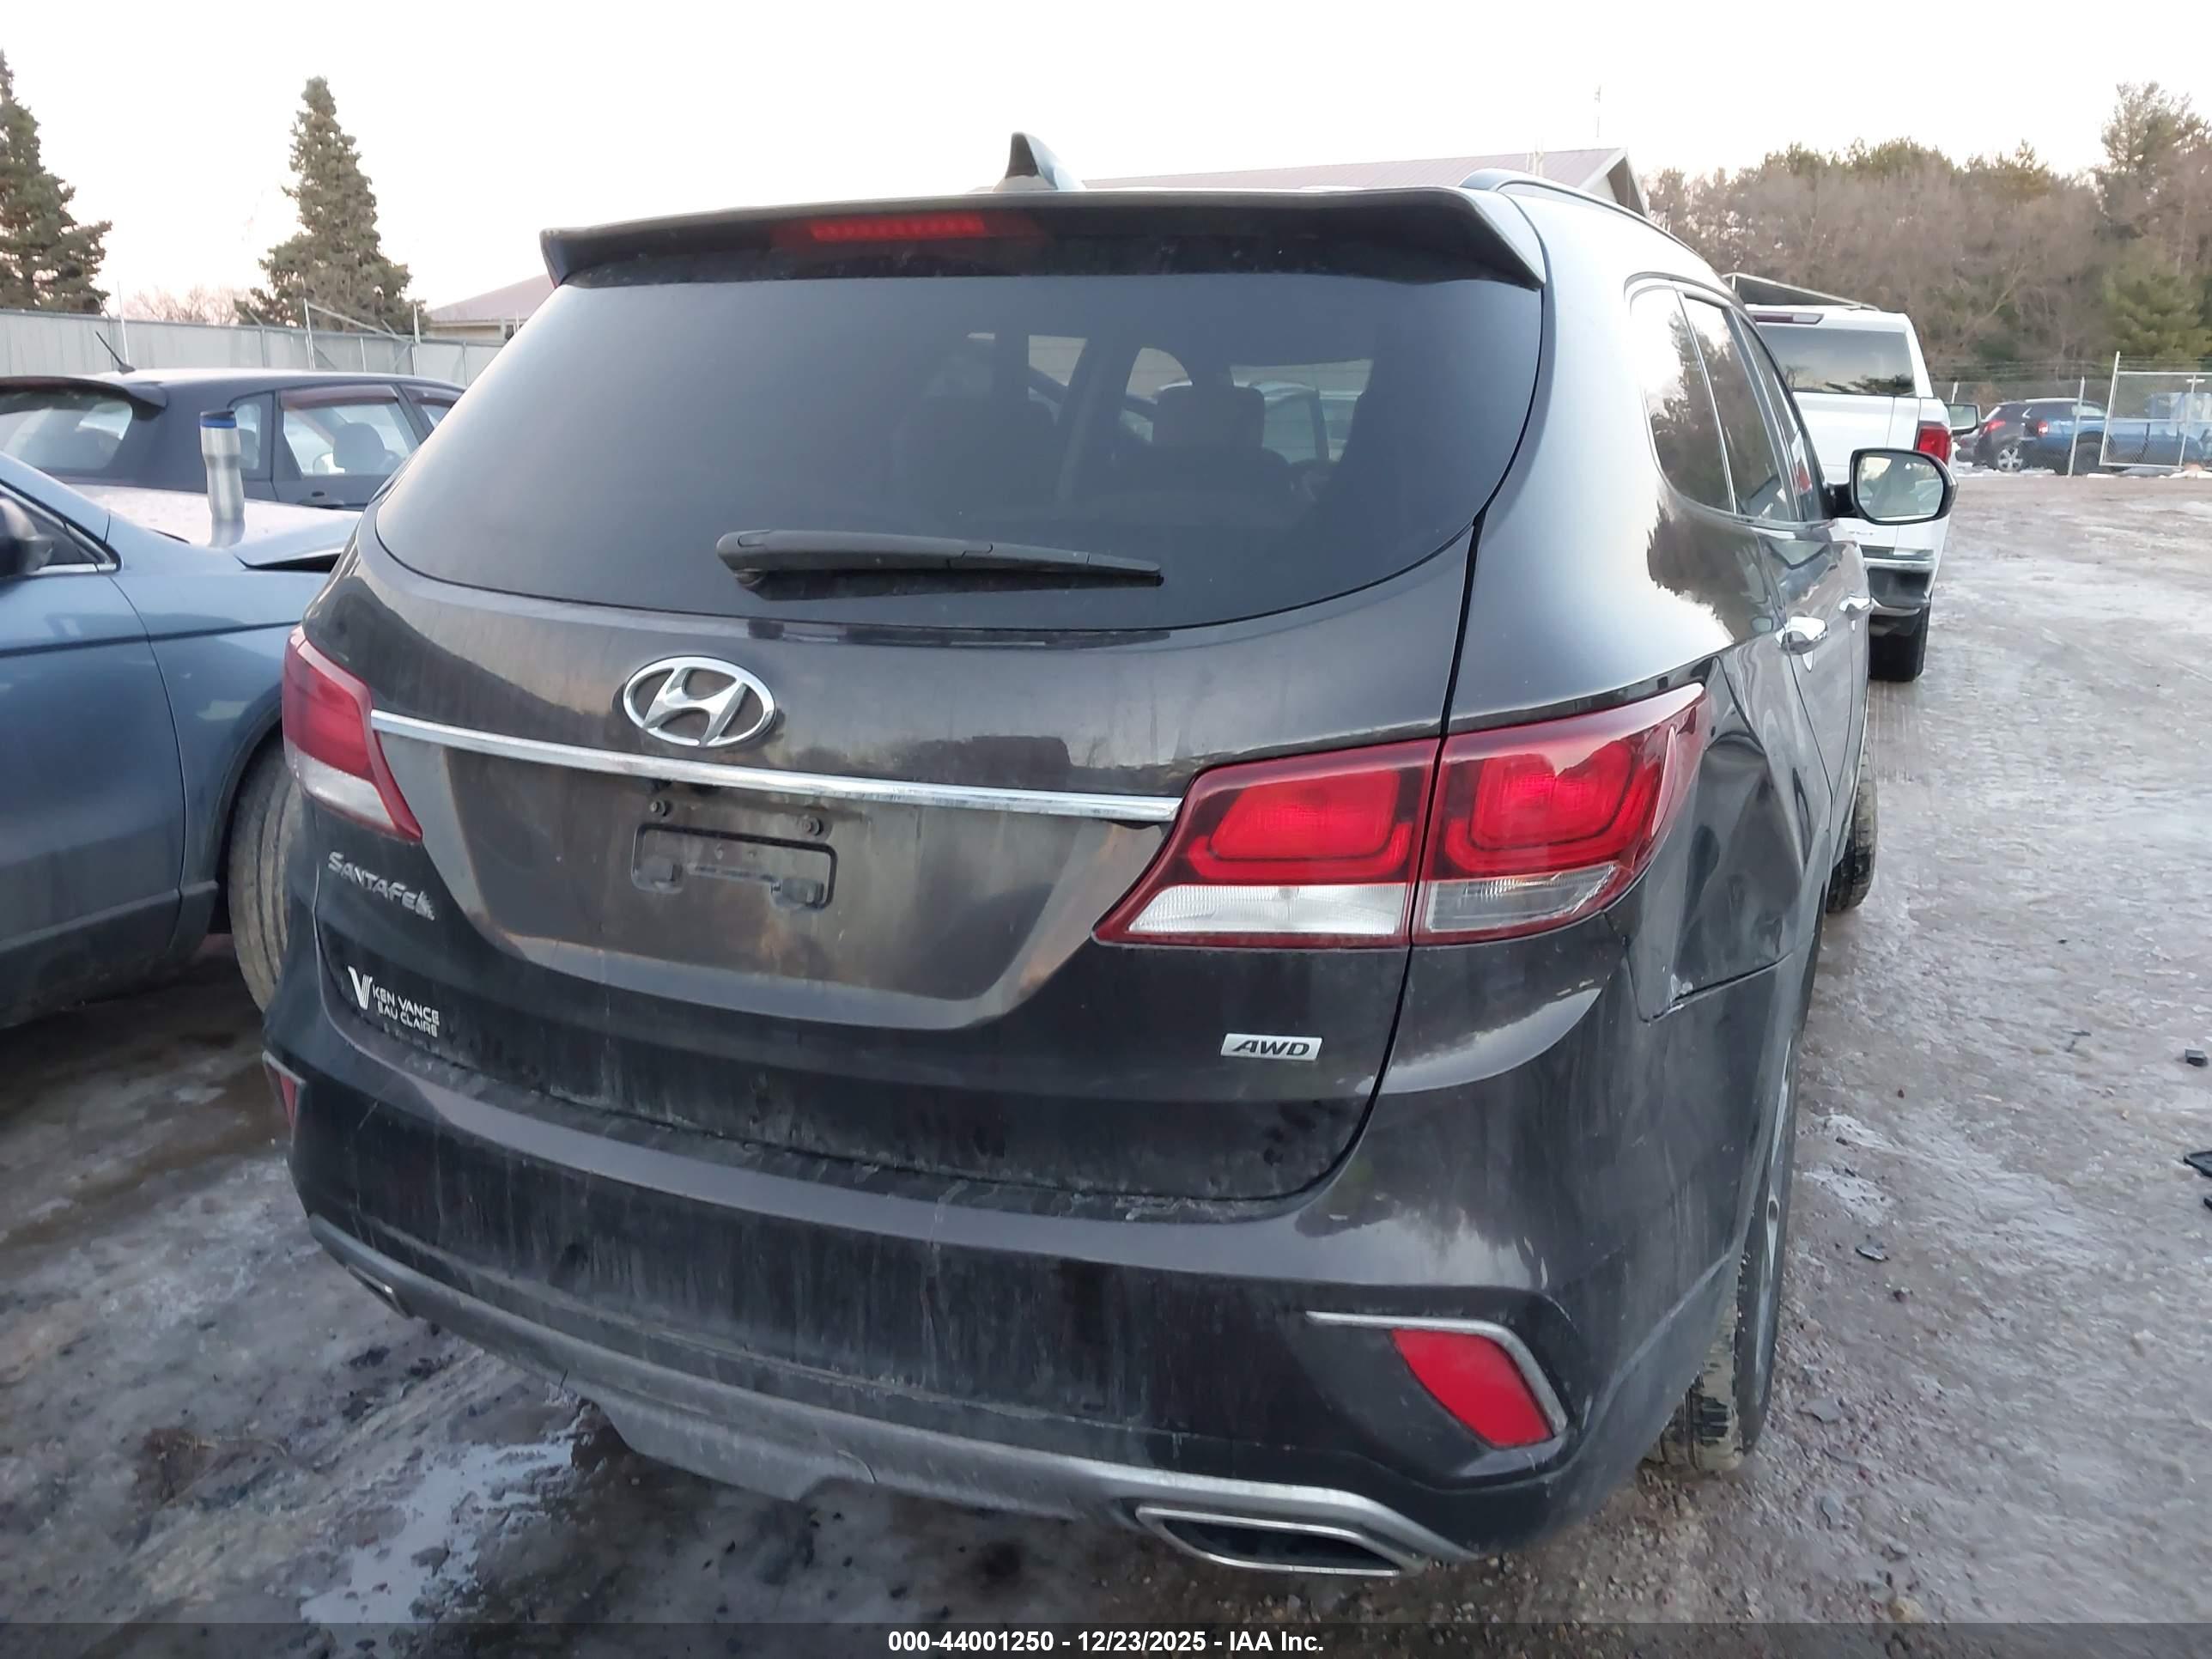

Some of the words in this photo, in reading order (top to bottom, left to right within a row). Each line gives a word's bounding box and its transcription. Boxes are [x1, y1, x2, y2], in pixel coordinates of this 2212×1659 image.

[373, 983, 395, 1007] KEN
[398, 995, 440, 1026] VANCE
[400, 1012, 438, 1037] CLAIRE
[1233, 1039, 1310, 1056] AWD
